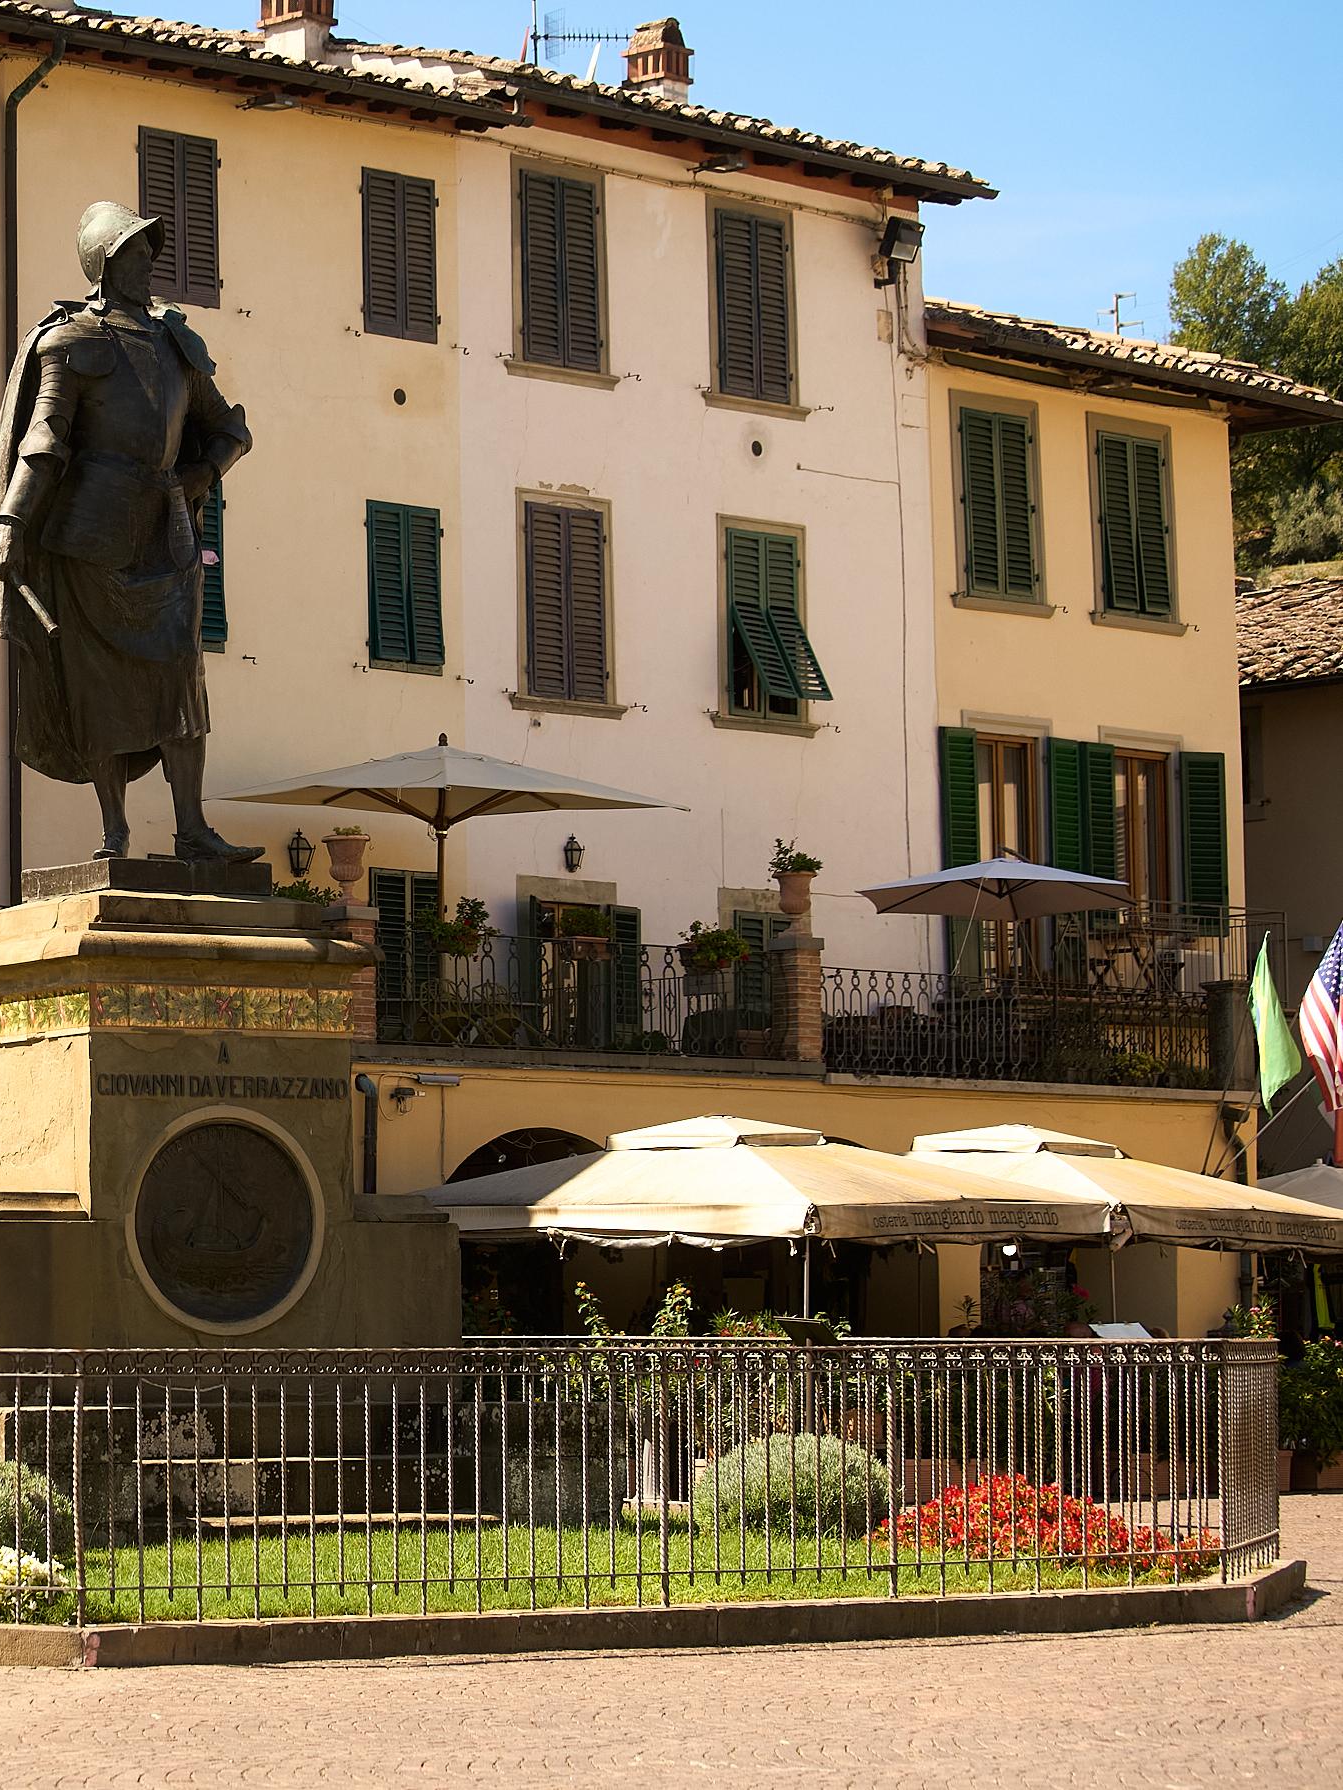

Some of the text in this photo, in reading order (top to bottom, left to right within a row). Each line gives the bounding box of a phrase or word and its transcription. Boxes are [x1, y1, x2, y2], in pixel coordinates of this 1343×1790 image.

[216, 1039, 232, 1065] A
[96, 1073, 349, 1100] GIOVANNI DA VERRAZZANO
[872, 1206, 1059, 1230] osteria mangiando mangiando
[1208, 1215, 1272, 1236] mangiando
[1275, 1219, 1338, 1242] mangiando
